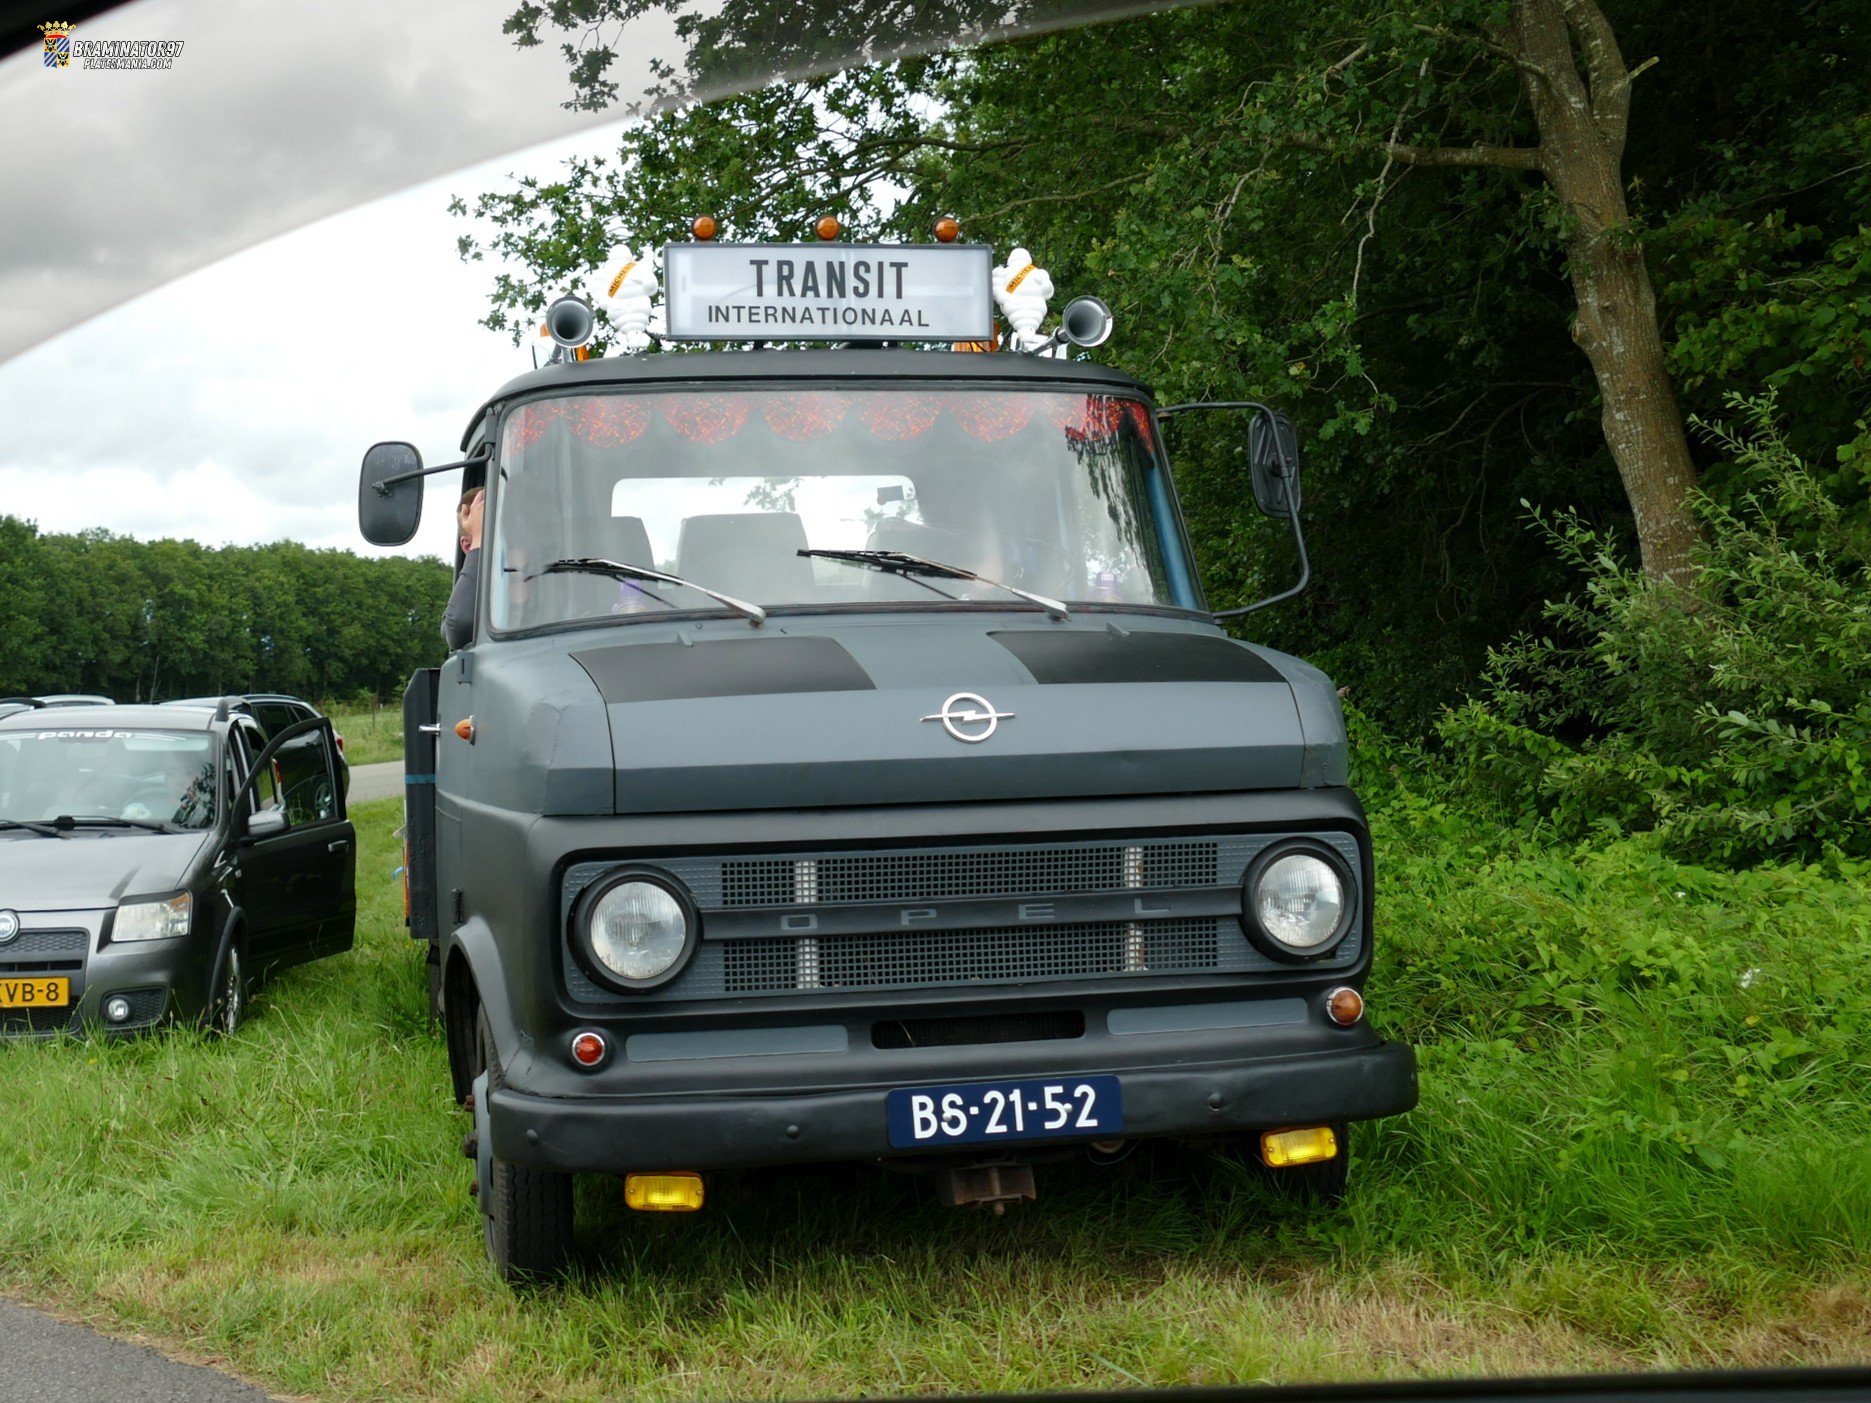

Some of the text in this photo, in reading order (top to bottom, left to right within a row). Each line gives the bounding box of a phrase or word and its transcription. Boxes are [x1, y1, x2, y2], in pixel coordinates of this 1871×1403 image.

[750, 259, 909, 300] TRANSIT
[708, 305, 930, 328] INTERNATIONAAL
[38, 730, 132, 741] panda
[780, 898, 1172, 931] OPEL
[0, 981, 60, 1003] VB-8
